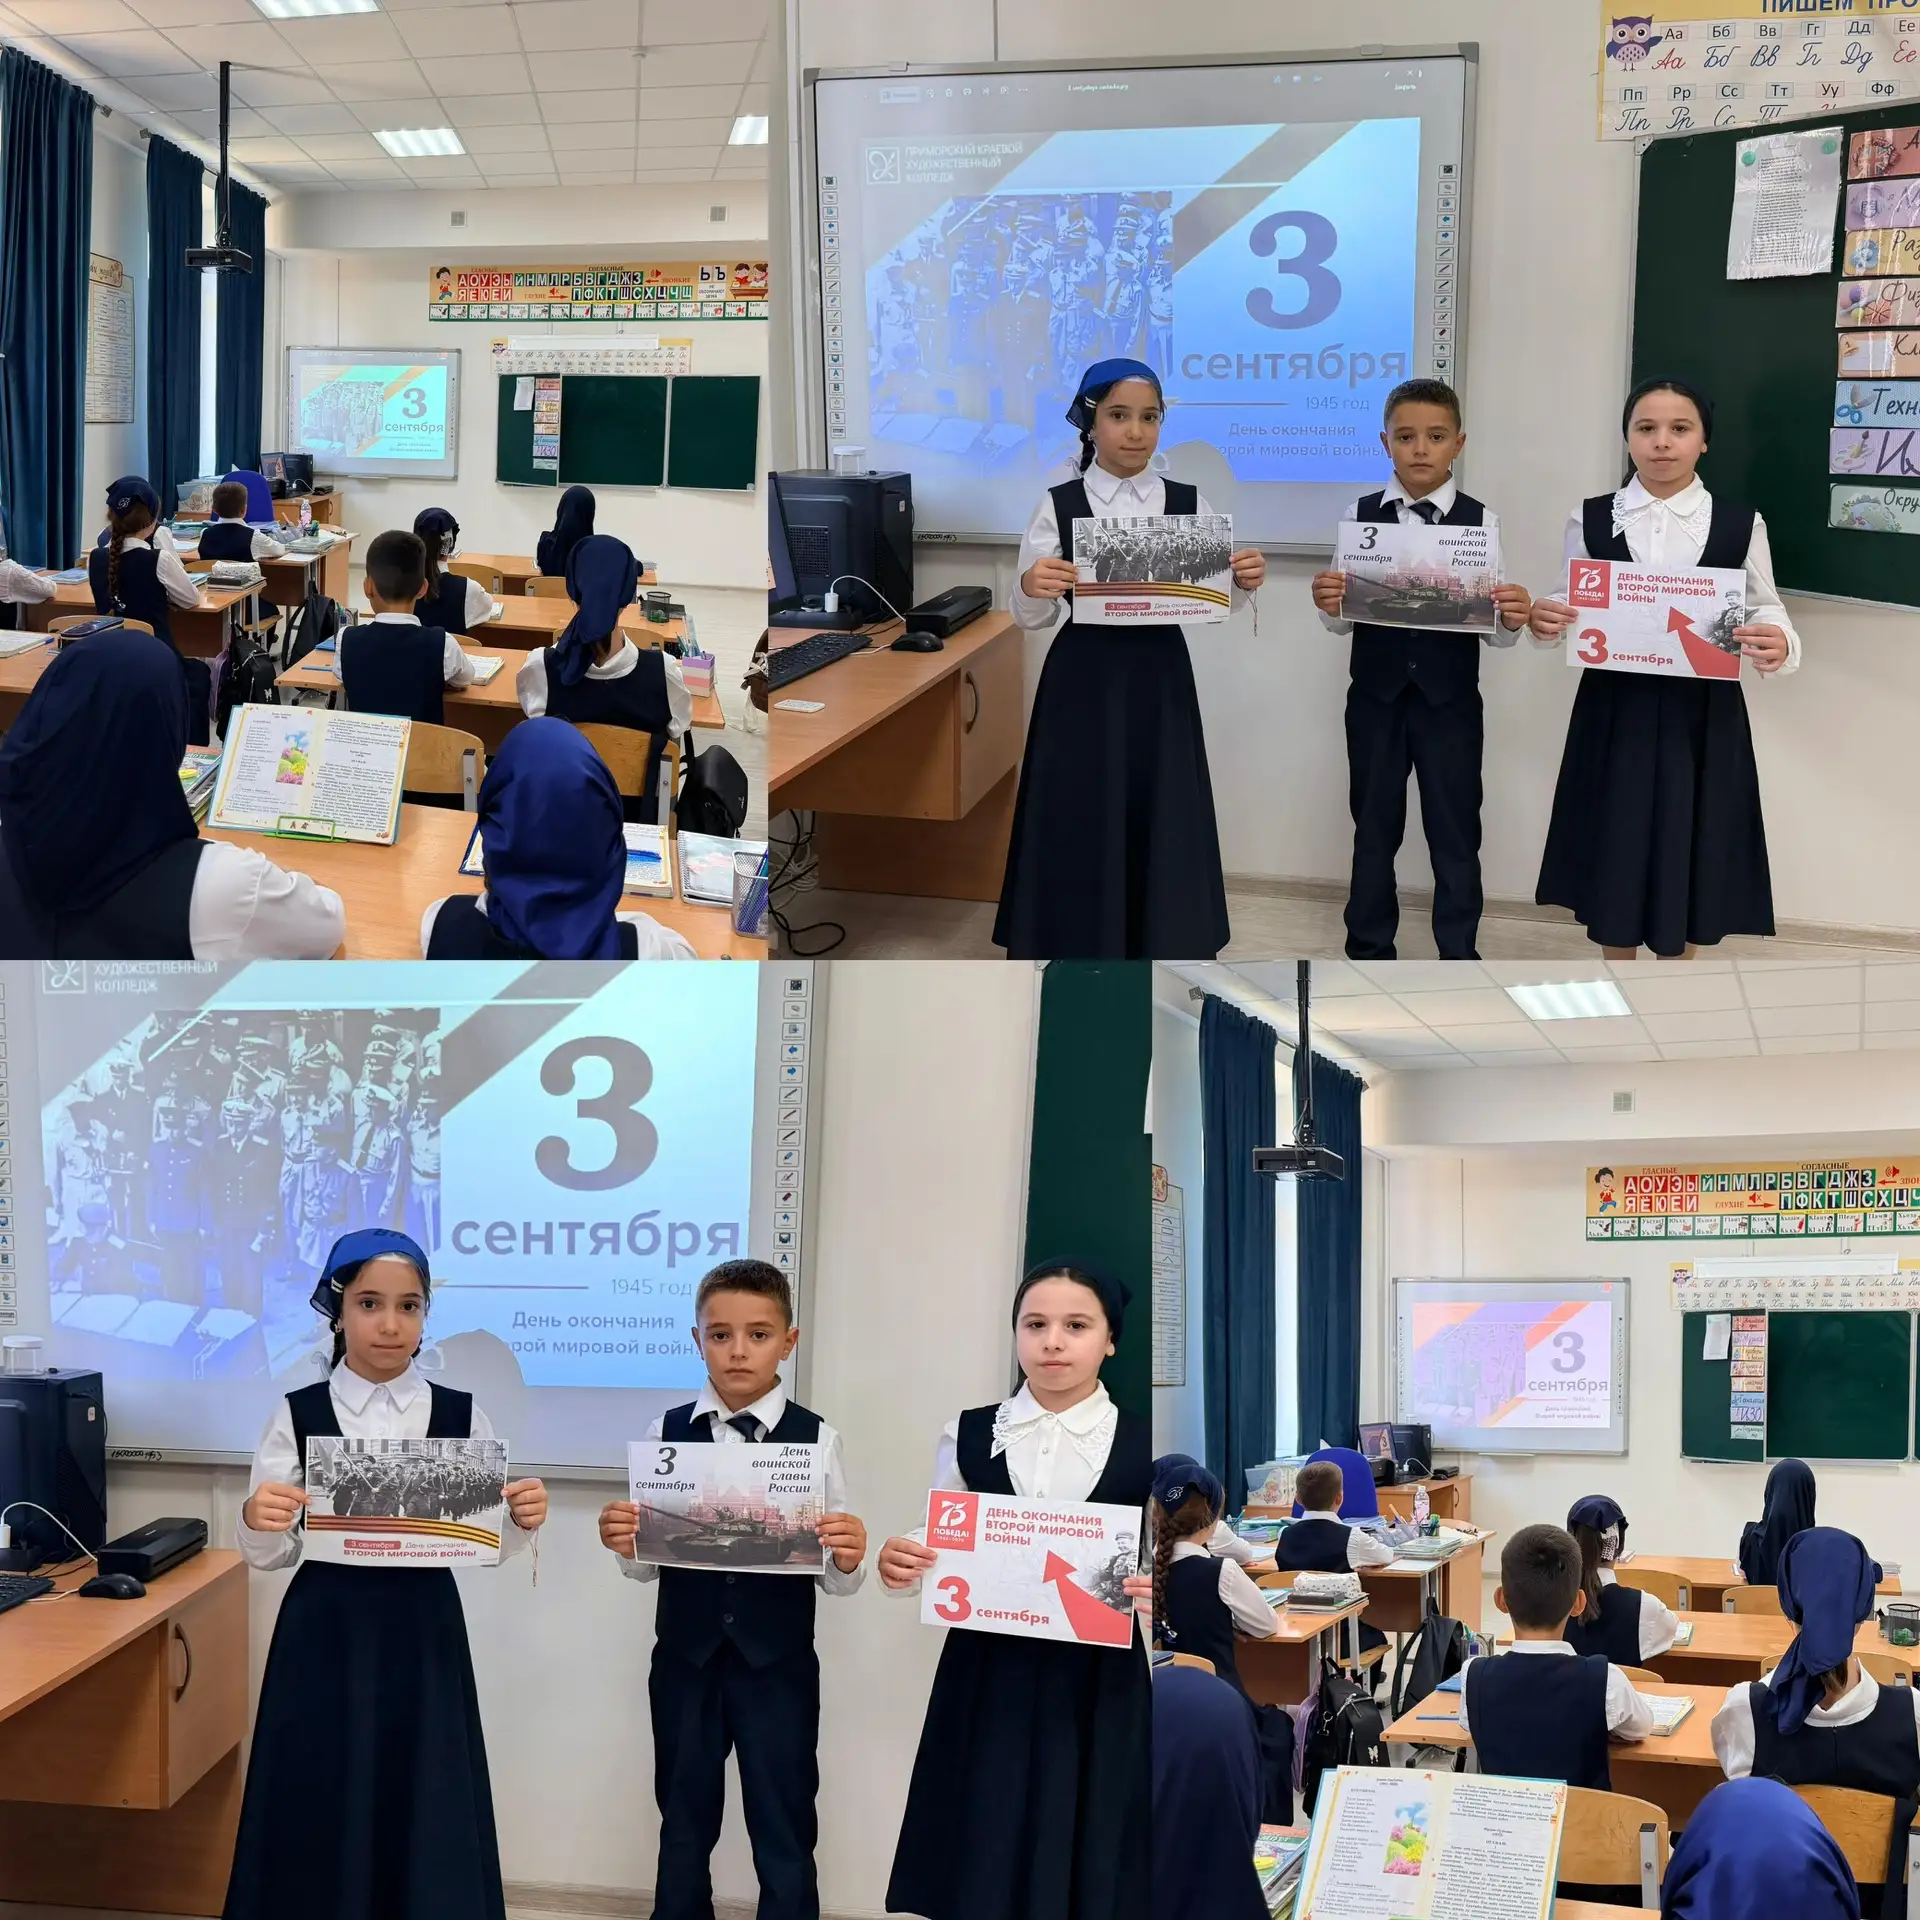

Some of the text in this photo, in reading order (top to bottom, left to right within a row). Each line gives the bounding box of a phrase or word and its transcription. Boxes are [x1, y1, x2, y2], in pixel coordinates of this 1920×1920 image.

[1664, 19, 1916, 40] Аа Бб Вв Гг Дд Ее
[1651, 40, 1918, 74] Аа Бб Вв Гг Дд Ее
[1623, 82, 1895, 101] Пп Рр Сс Тт Уу Фф
[1615, 107, 1651, 132] Пп
[1665, 106, 1695, 132] Рр
[1245, 210, 1342, 330] 3
[1181, 343, 1406, 388] сентября
[401, 387, 428, 419] 3
[1305, 397, 1370, 411] 1945 год
[384, 421, 444, 435] сентября
[1228, 423, 1356, 437] День окончания
[1217, 443, 1255, 458] орой
[1260, 444, 1329, 458] мировой
[1359, 526, 1379, 550] 3
[1461, 528, 1488, 539] День
[1438, 537, 1487, 548] воинской
[1343, 553, 1393, 563] сентября
[1451, 558, 1487, 567] России
[1617, 572, 1714, 587] ДЕНЬ ОКОНЧАНИЯ
[1617, 582, 1716, 597] ВТОРОЙ МИРОВОЙ
[1617, 592, 1656, 604] ВОЙНЫ
[1104, 608, 1212, 618] ВТОРОЙ МИРОВОЙ ВОЙНЫ
[1577, 628, 1673, 666] 3 сентября
[94, 961, 218, 975] ХУДОЖЕСТВЕННЫЙ
[94, 980, 158, 994] КОЛЛЕДЖ
[535, 1035, 659, 1192] 3
[1801, 1162, 1850, 1171] СОГЛАСНЫЕ
[451, 1209, 740, 1268] сентября
[611, 1279, 693, 1297] 1945 год
[511, 1311, 675, 1330] День окончания
[552, 1341, 640, 1357] мировой
[1551, 1331, 1586, 1374] 3
[1528, 1377, 1608, 1395] сентября
[779, 1446, 811, 1457] День
[655, 1446, 678, 1476] 3
[751, 1457, 811, 1469] воинской
[771, 1472, 811, 1481] славы
[635, 1480, 696, 1492] сентября
[767, 1483, 811, 1493] России
[986, 1507, 1102, 1527] ДЕНЬ ОКОНЧАНИЯ
[933, 1527, 970, 1538] ПОБЕДА!
[985, 1520, 1104, 1540] ВТОРОЙ МИРОВОЙ
[358, 1541, 395, 1550] сентября
[405, 1541, 426, 1549] День
[984, 1533, 1031, 1546] ВОЙНЫ
[344, 1549, 477, 1558] ВТОРОЙ МИРОВОЙ ВОЙНЫ
[933, 1575, 1050, 1626] 3 сентября
